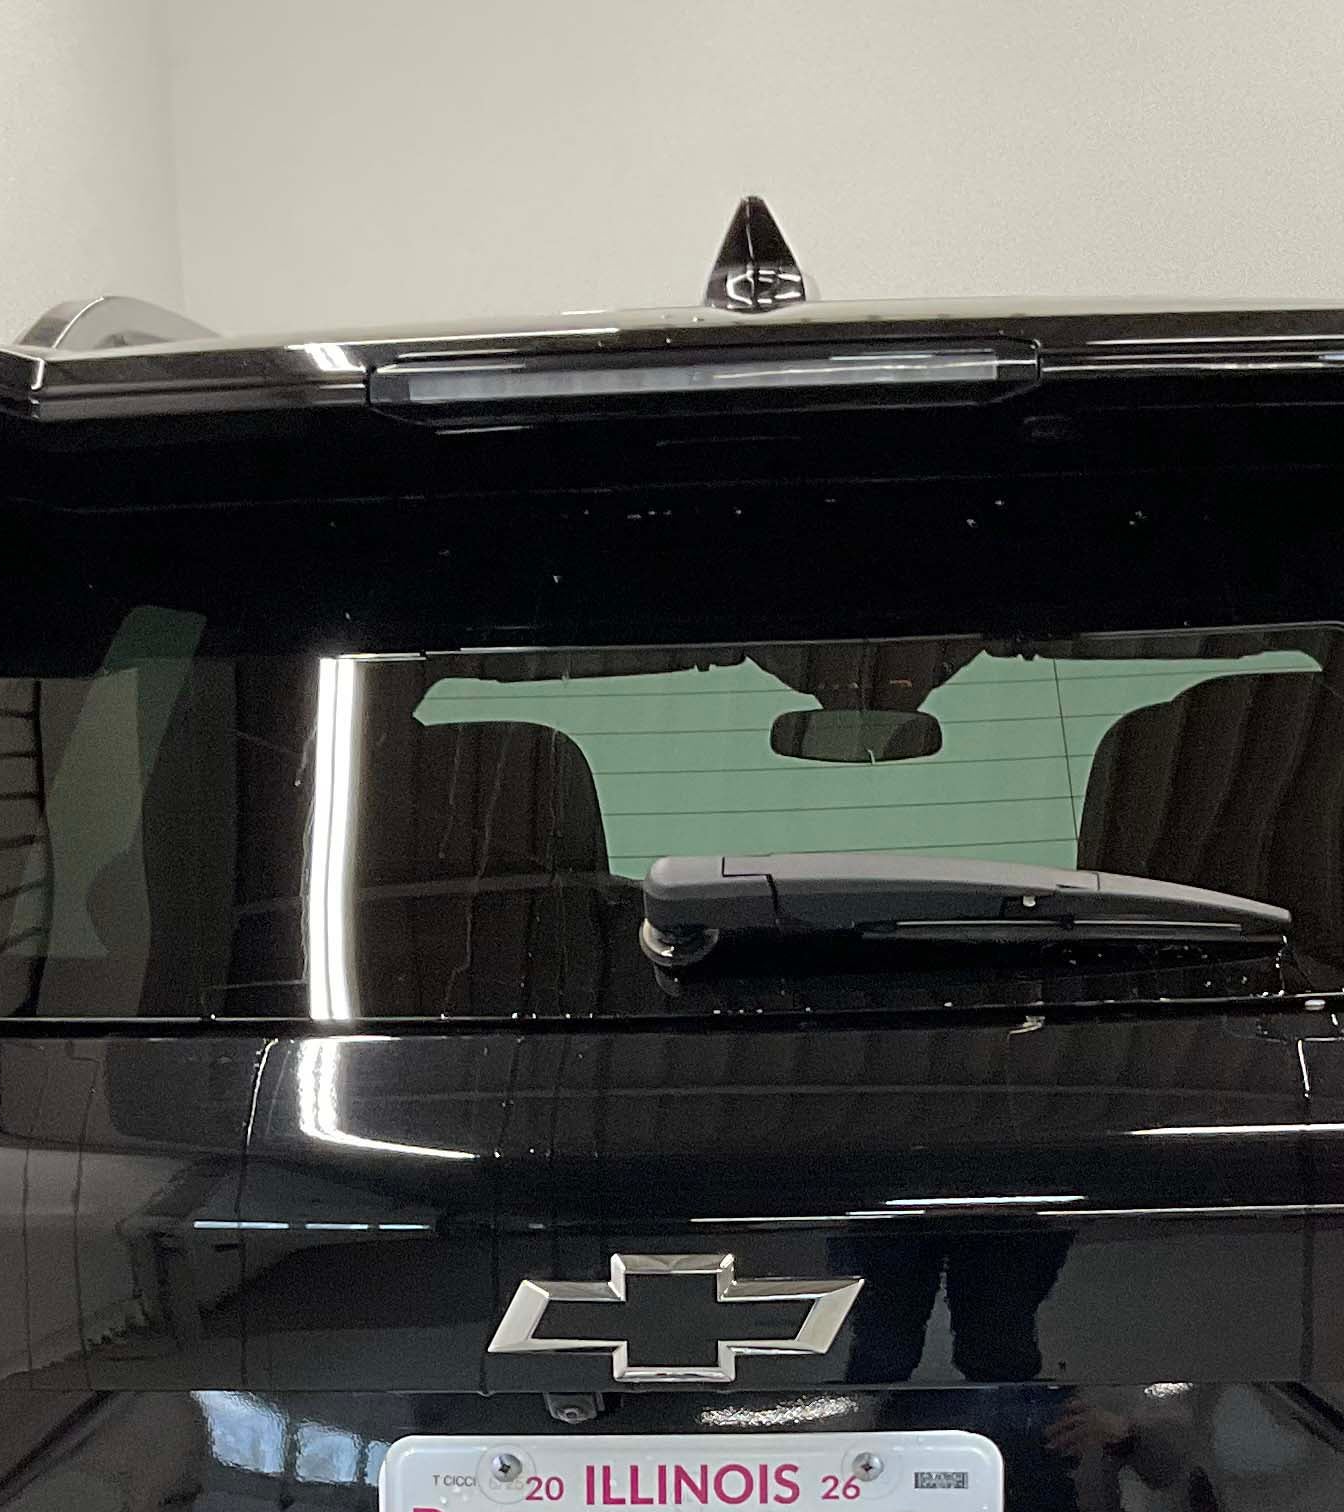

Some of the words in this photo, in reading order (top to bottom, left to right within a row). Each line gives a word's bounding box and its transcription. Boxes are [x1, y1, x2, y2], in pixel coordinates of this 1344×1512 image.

[526, 1476, 565, 1502] 20
[585, 1464, 801, 1505] ILLINOIS
[821, 1475, 861, 1501] 26
